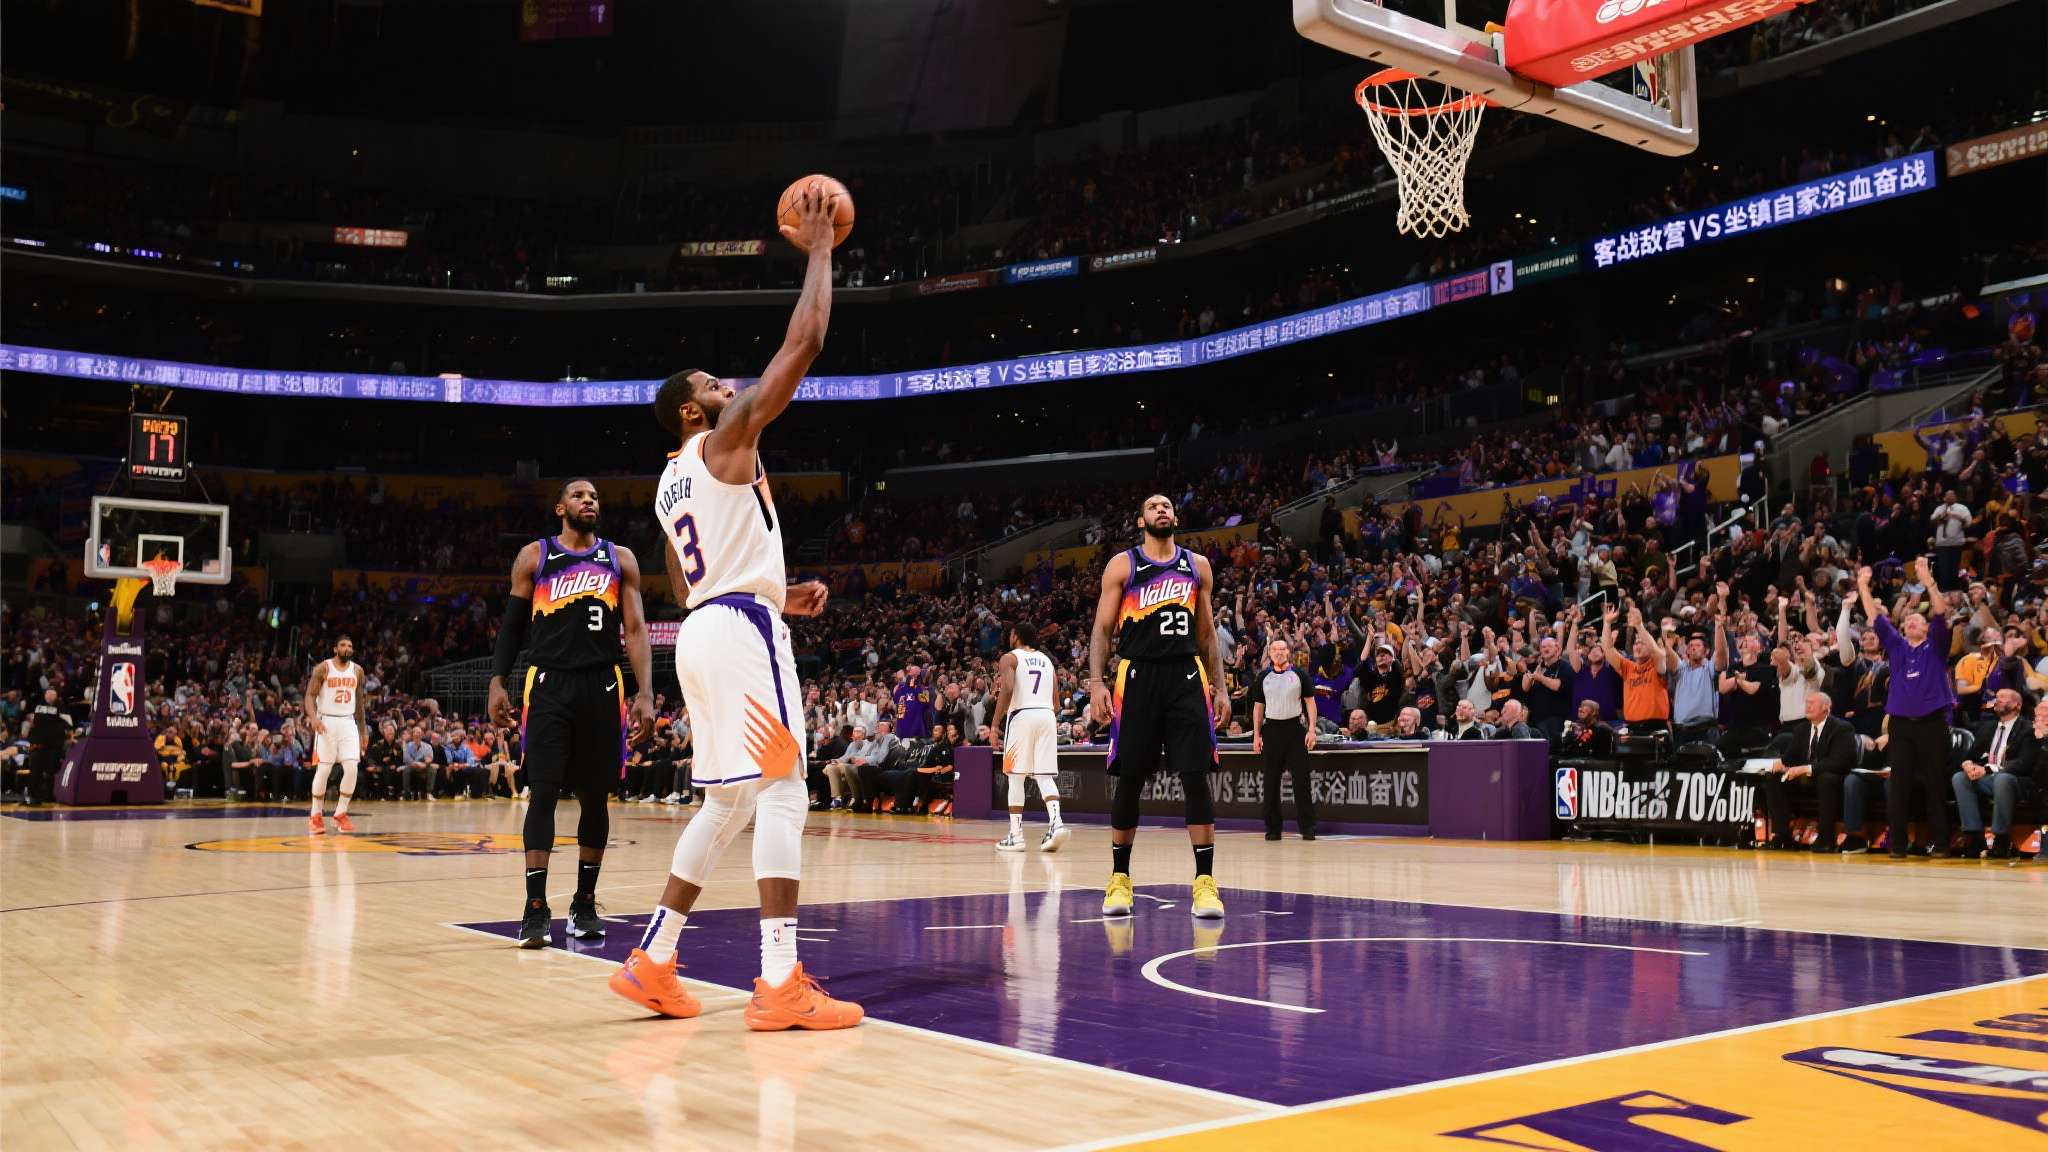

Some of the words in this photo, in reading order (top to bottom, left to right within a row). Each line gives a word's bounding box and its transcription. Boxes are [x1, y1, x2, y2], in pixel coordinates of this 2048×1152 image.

[150, 434, 174, 463] 17
[673, 513, 706, 588] 3
[550, 570, 611, 601] Valley
[1140, 578, 1192, 610] Valley
[587, 605, 603, 631] 3
[1160, 611, 1189, 636] 23
[1028, 670, 1041, 694] 7
[1675, 772, 1727, 822] 70%
